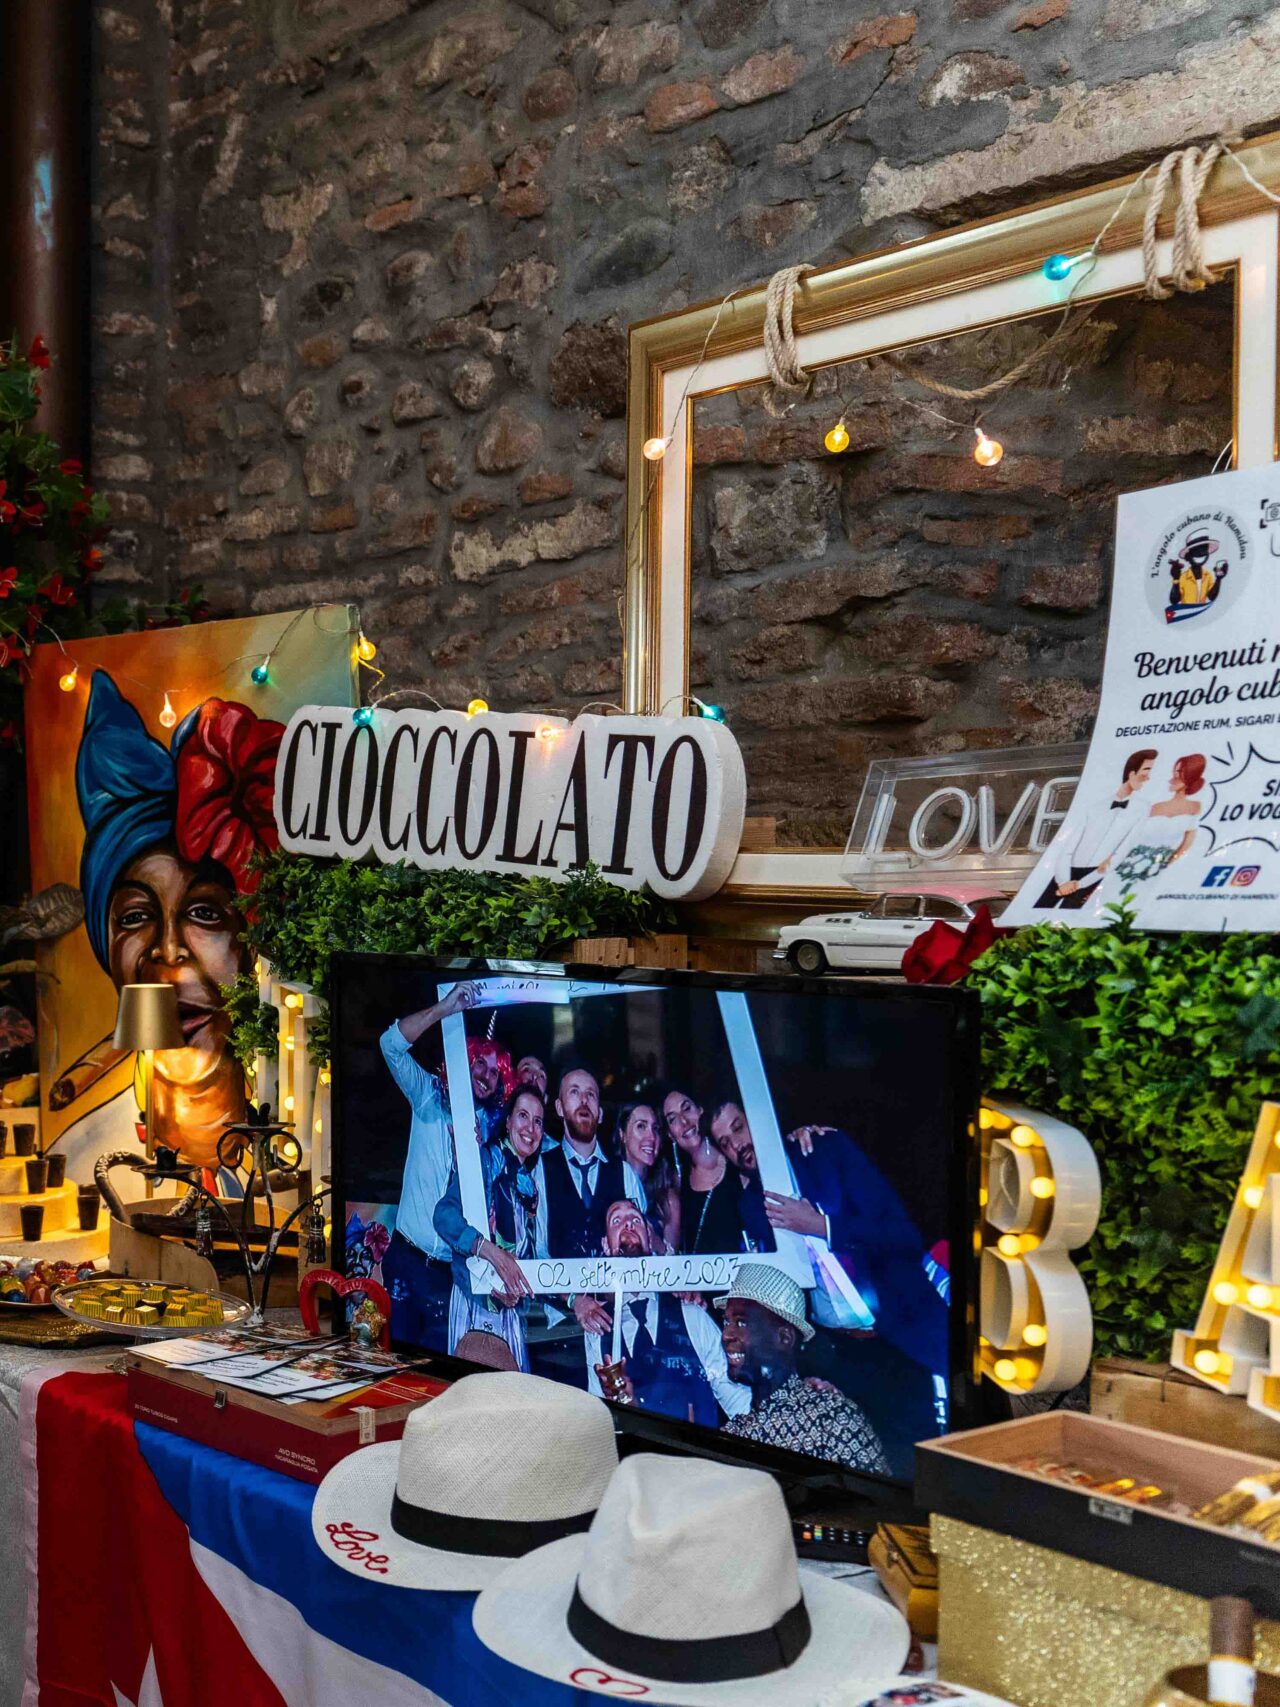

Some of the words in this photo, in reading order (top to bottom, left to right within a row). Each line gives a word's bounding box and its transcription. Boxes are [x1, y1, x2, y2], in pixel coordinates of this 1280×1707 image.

[1150, 532, 1176, 579] L'angolo
[1176, 513, 1211, 533] cubano
[1213, 511, 1225, 522] di
[1134, 638, 1267, 679] Benvenuti
[1140, 675, 1233, 720] angolo
[1115, 720, 1201, 738] DEGUSTAZIONE
[1234, 713, 1275, 728] SIGARI
[281, 718, 708, 883] CIOCCOLATO
[864, 775, 1081, 863] LOVE
[1219, 803, 1244, 822] LO
[536, 1261, 571, 1289] 02
[579, 1259, 681, 1290] settembre
[324, 1521, 390, 1575] Love
